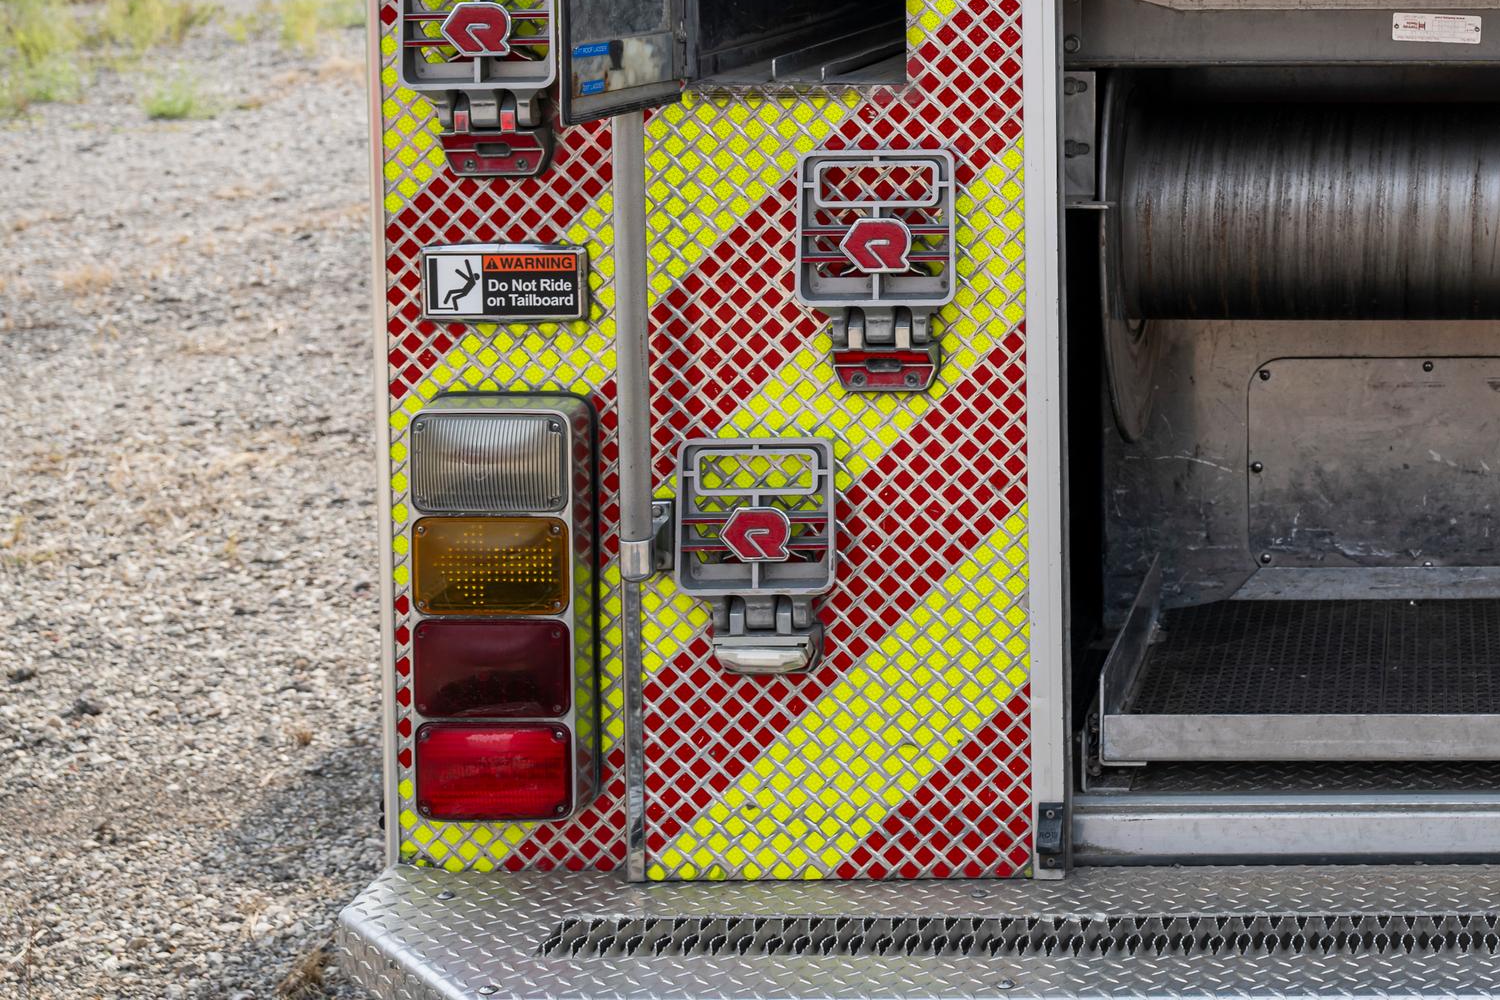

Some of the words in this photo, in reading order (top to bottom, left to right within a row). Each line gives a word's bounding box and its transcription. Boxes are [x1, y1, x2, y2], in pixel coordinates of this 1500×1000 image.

[500, 257, 573, 269] WARNING
[488, 279, 509, 292] Do
[511, 279, 537, 292] Not
[540, 278, 573, 292] Ride
[487, 296, 506, 307] on
[508, 293, 574, 307] Tailboard
